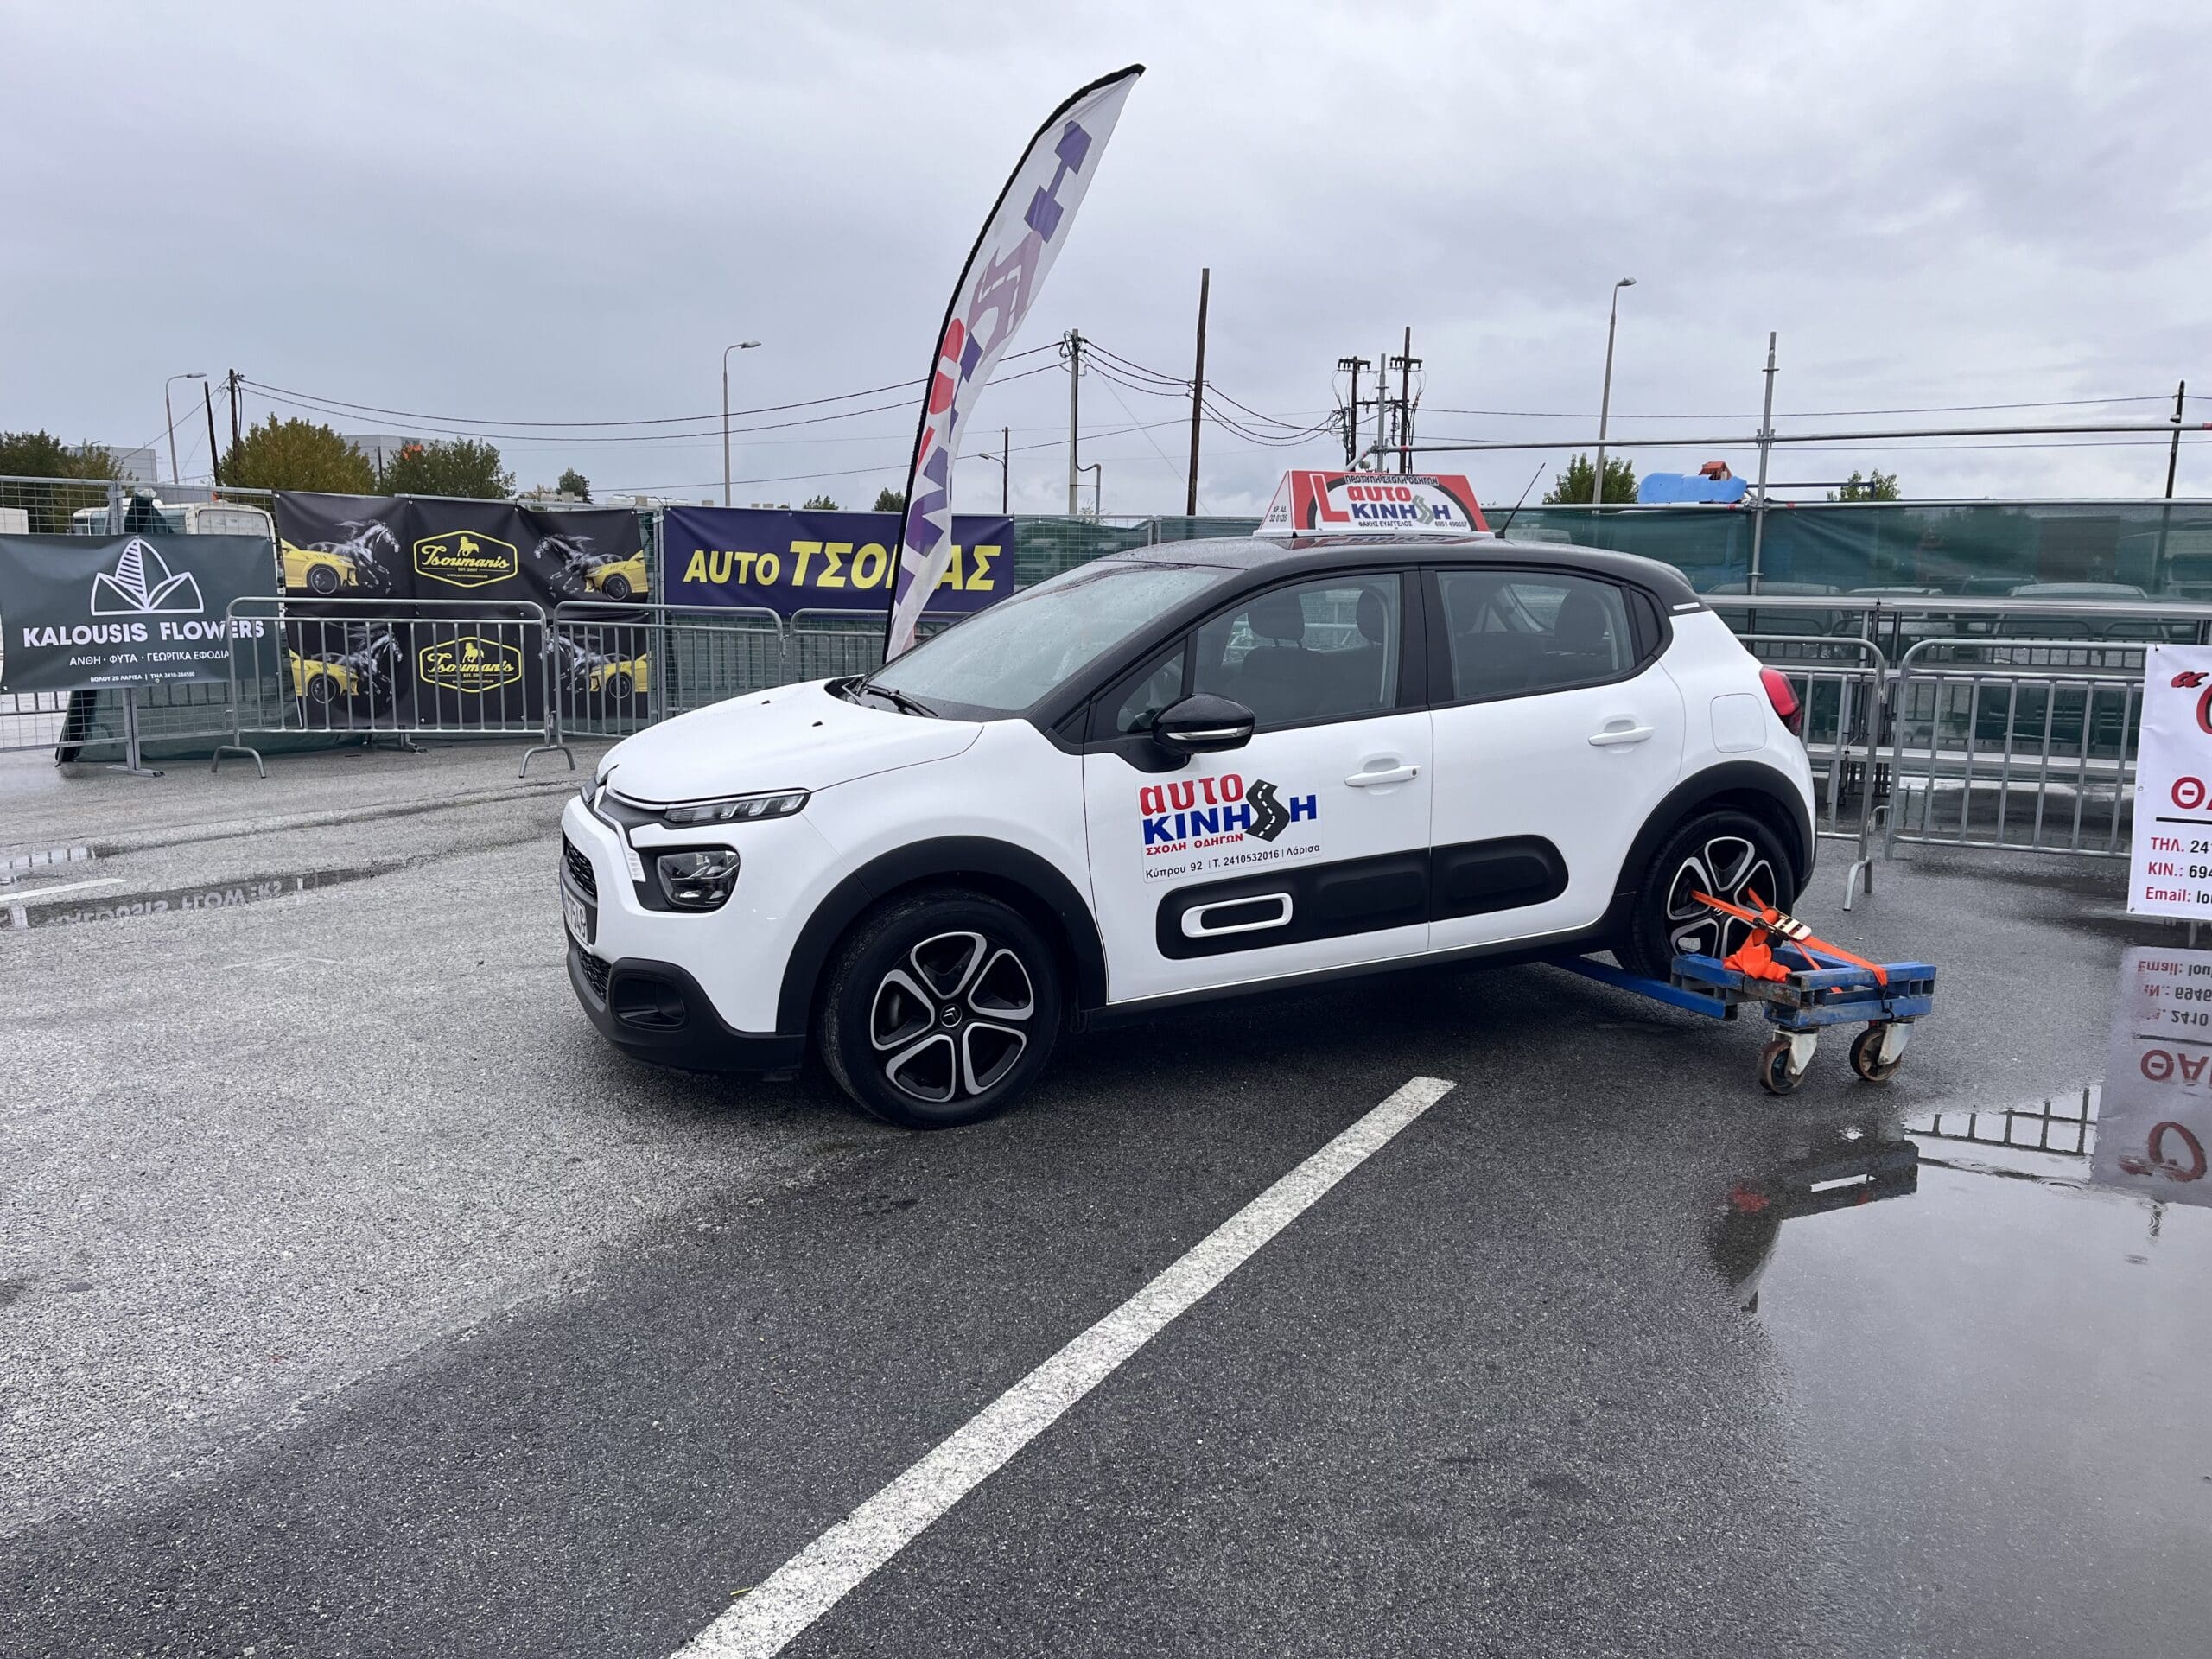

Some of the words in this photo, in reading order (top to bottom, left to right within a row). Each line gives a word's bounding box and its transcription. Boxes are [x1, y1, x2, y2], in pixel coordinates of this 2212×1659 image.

[421, 544, 511, 569] Tsoumanis
[23, 621, 148, 648] KALOUSIS
[160, 620, 264, 641] FLOWERS
[69, 655, 101, 666] ΑΝΘΗ
[109, 653, 138, 664] ΦΥΤΑ
[146, 651, 192, 662] ΓΕΩΡΓΙΚΑ
[2171, 776, 2212, 810] Θ
[1146, 842, 1186, 855] ΣΧΟΛΗ
[1194, 833, 1243, 849] ΟΔΗΓΩΝ
[2150, 836, 2185, 852] ΤΗΛ.
[2190, 840, 2212, 854] 24
[1145, 865, 1186, 879] Κύπρου
[1190, 861, 1203, 872] 92
[1223, 849, 1280, 867] 2410532016
[1286, 843, 1320, 857] Λάρισα
[2145, 887, 2191, 903] Email:
[2196, 890, 2212, 904] lo
